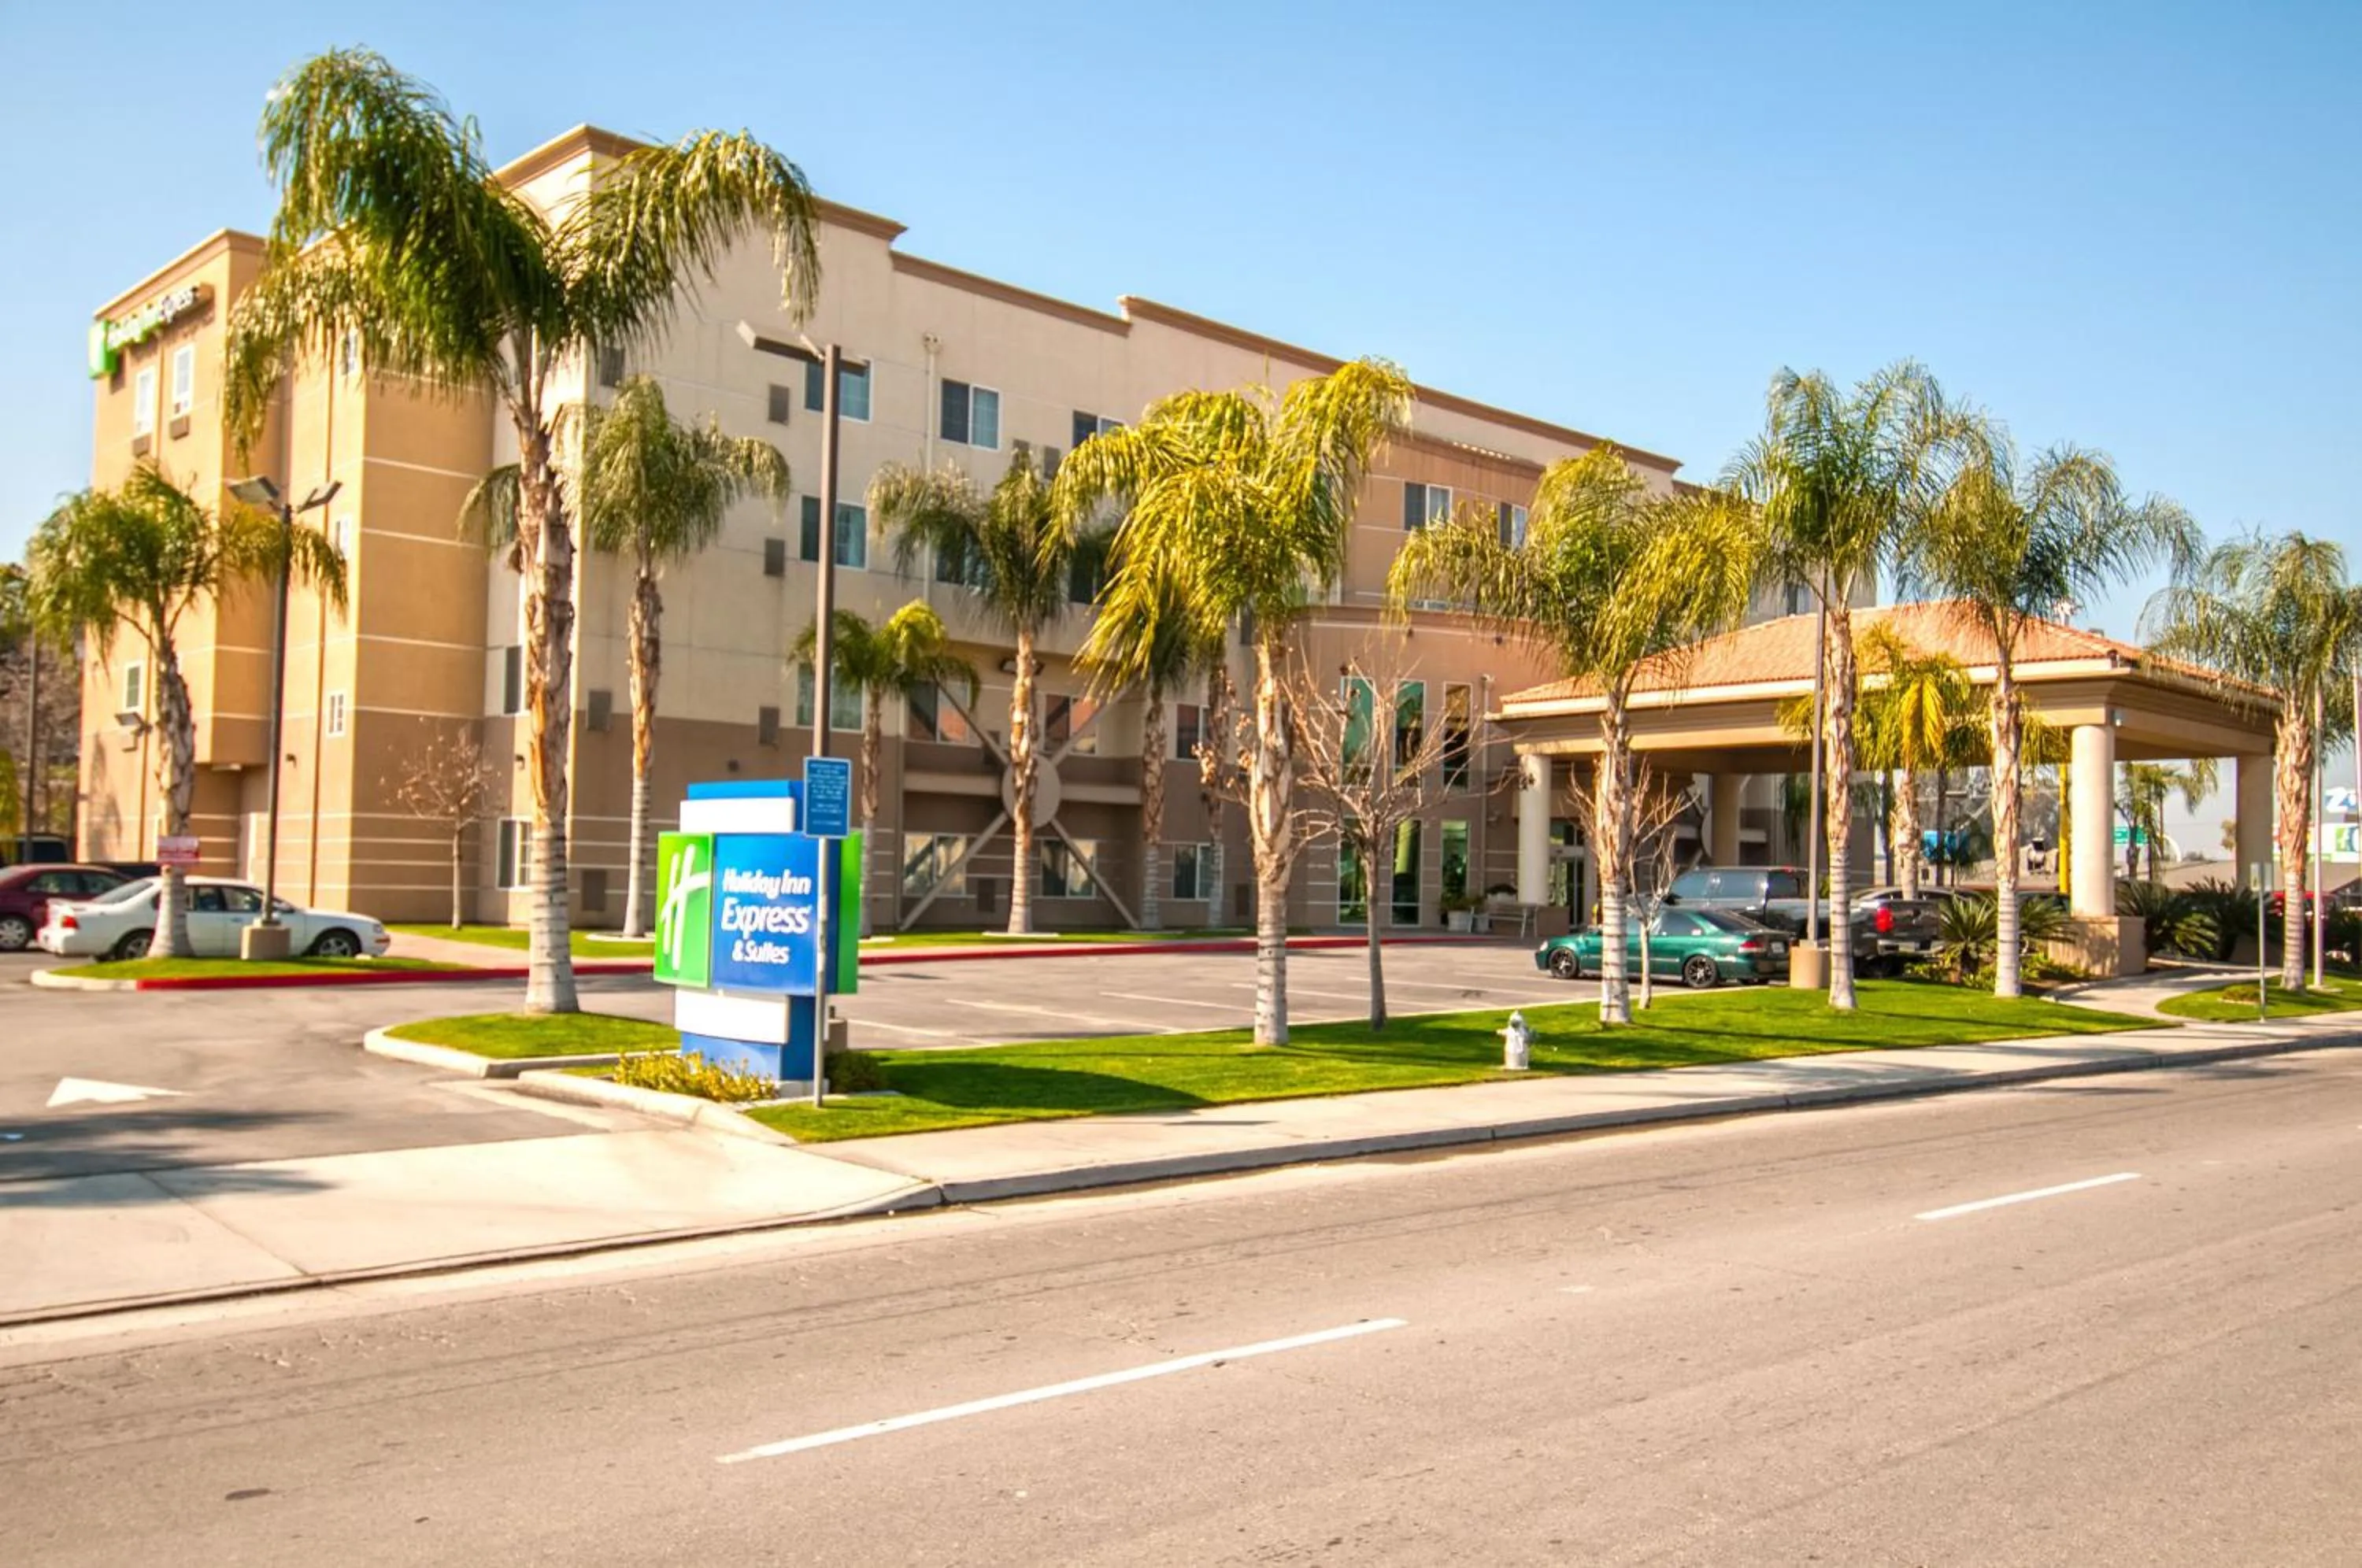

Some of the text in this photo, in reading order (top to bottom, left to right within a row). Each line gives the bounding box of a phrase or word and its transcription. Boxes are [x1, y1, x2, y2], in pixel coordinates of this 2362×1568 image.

[723, 867, 812, 899] Holiday Inn
[721, 897, 811, 940] Express
[732, 940, 790, 964] & Suites
